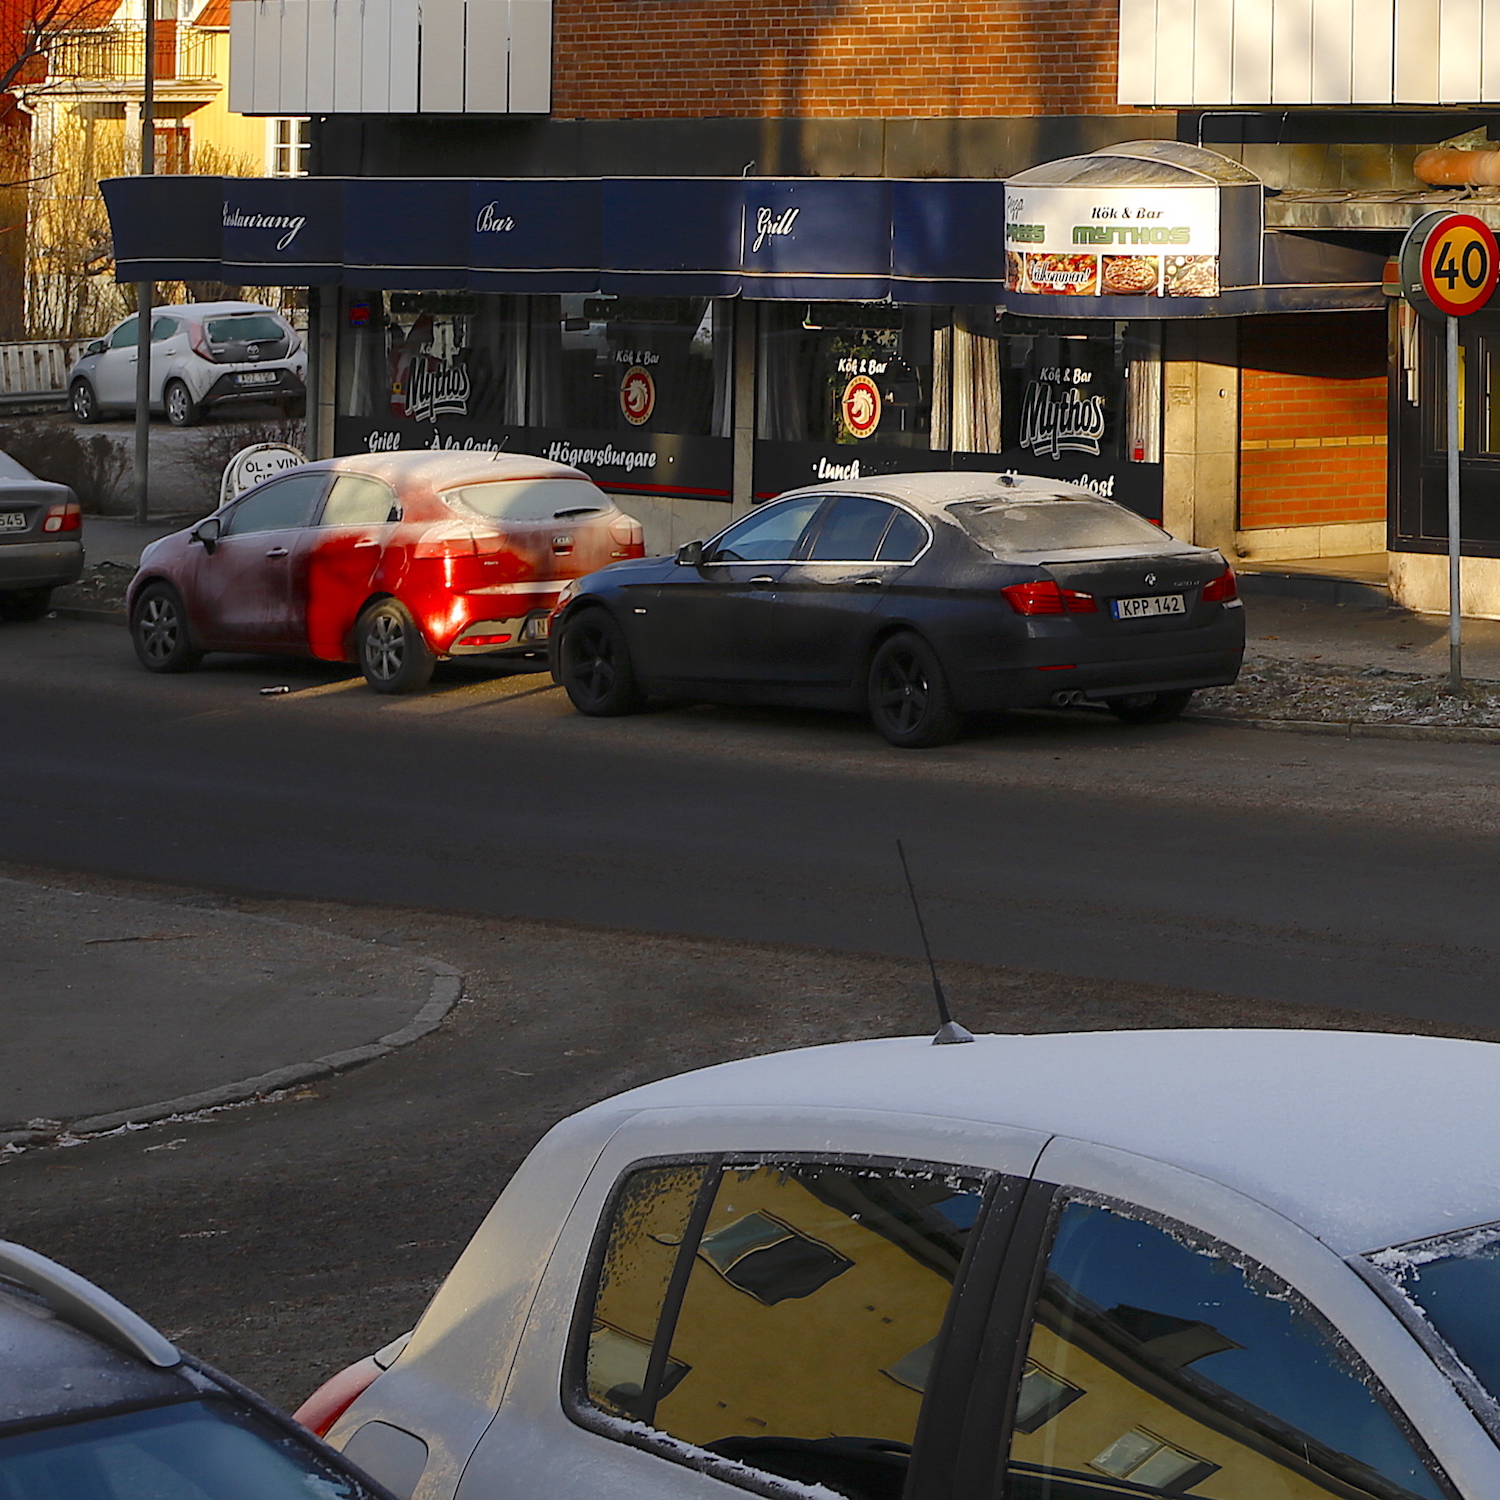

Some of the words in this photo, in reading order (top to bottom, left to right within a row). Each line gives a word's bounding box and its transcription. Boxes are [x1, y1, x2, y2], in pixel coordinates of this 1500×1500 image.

[476, 201, 515, 233] Bar
[1091, 206, 1118, 219] Kök
[1121, 207, 1132, 219] &
[1136, 207, 1164, 219] Bar
[753, 207, 799, 253] Grill
[1073, 226, 1190, 244] MYTHOS
[1434, 241, 1487, 290] 40
[868, 359, 887, 375] Bar
[1073, 368, 1092, 384] Bar
[1020, 381, 1104, 460] Mythos
[369, 431, 400, 453] Grill
[246, 460, 263, 472] ÖL
[277, 458, 298, 469] VIN
[818, 457, 859, 480] Lunch
[1123, 600, 1149, 616] KPP
[1155, 597, 1179, 612] 142
